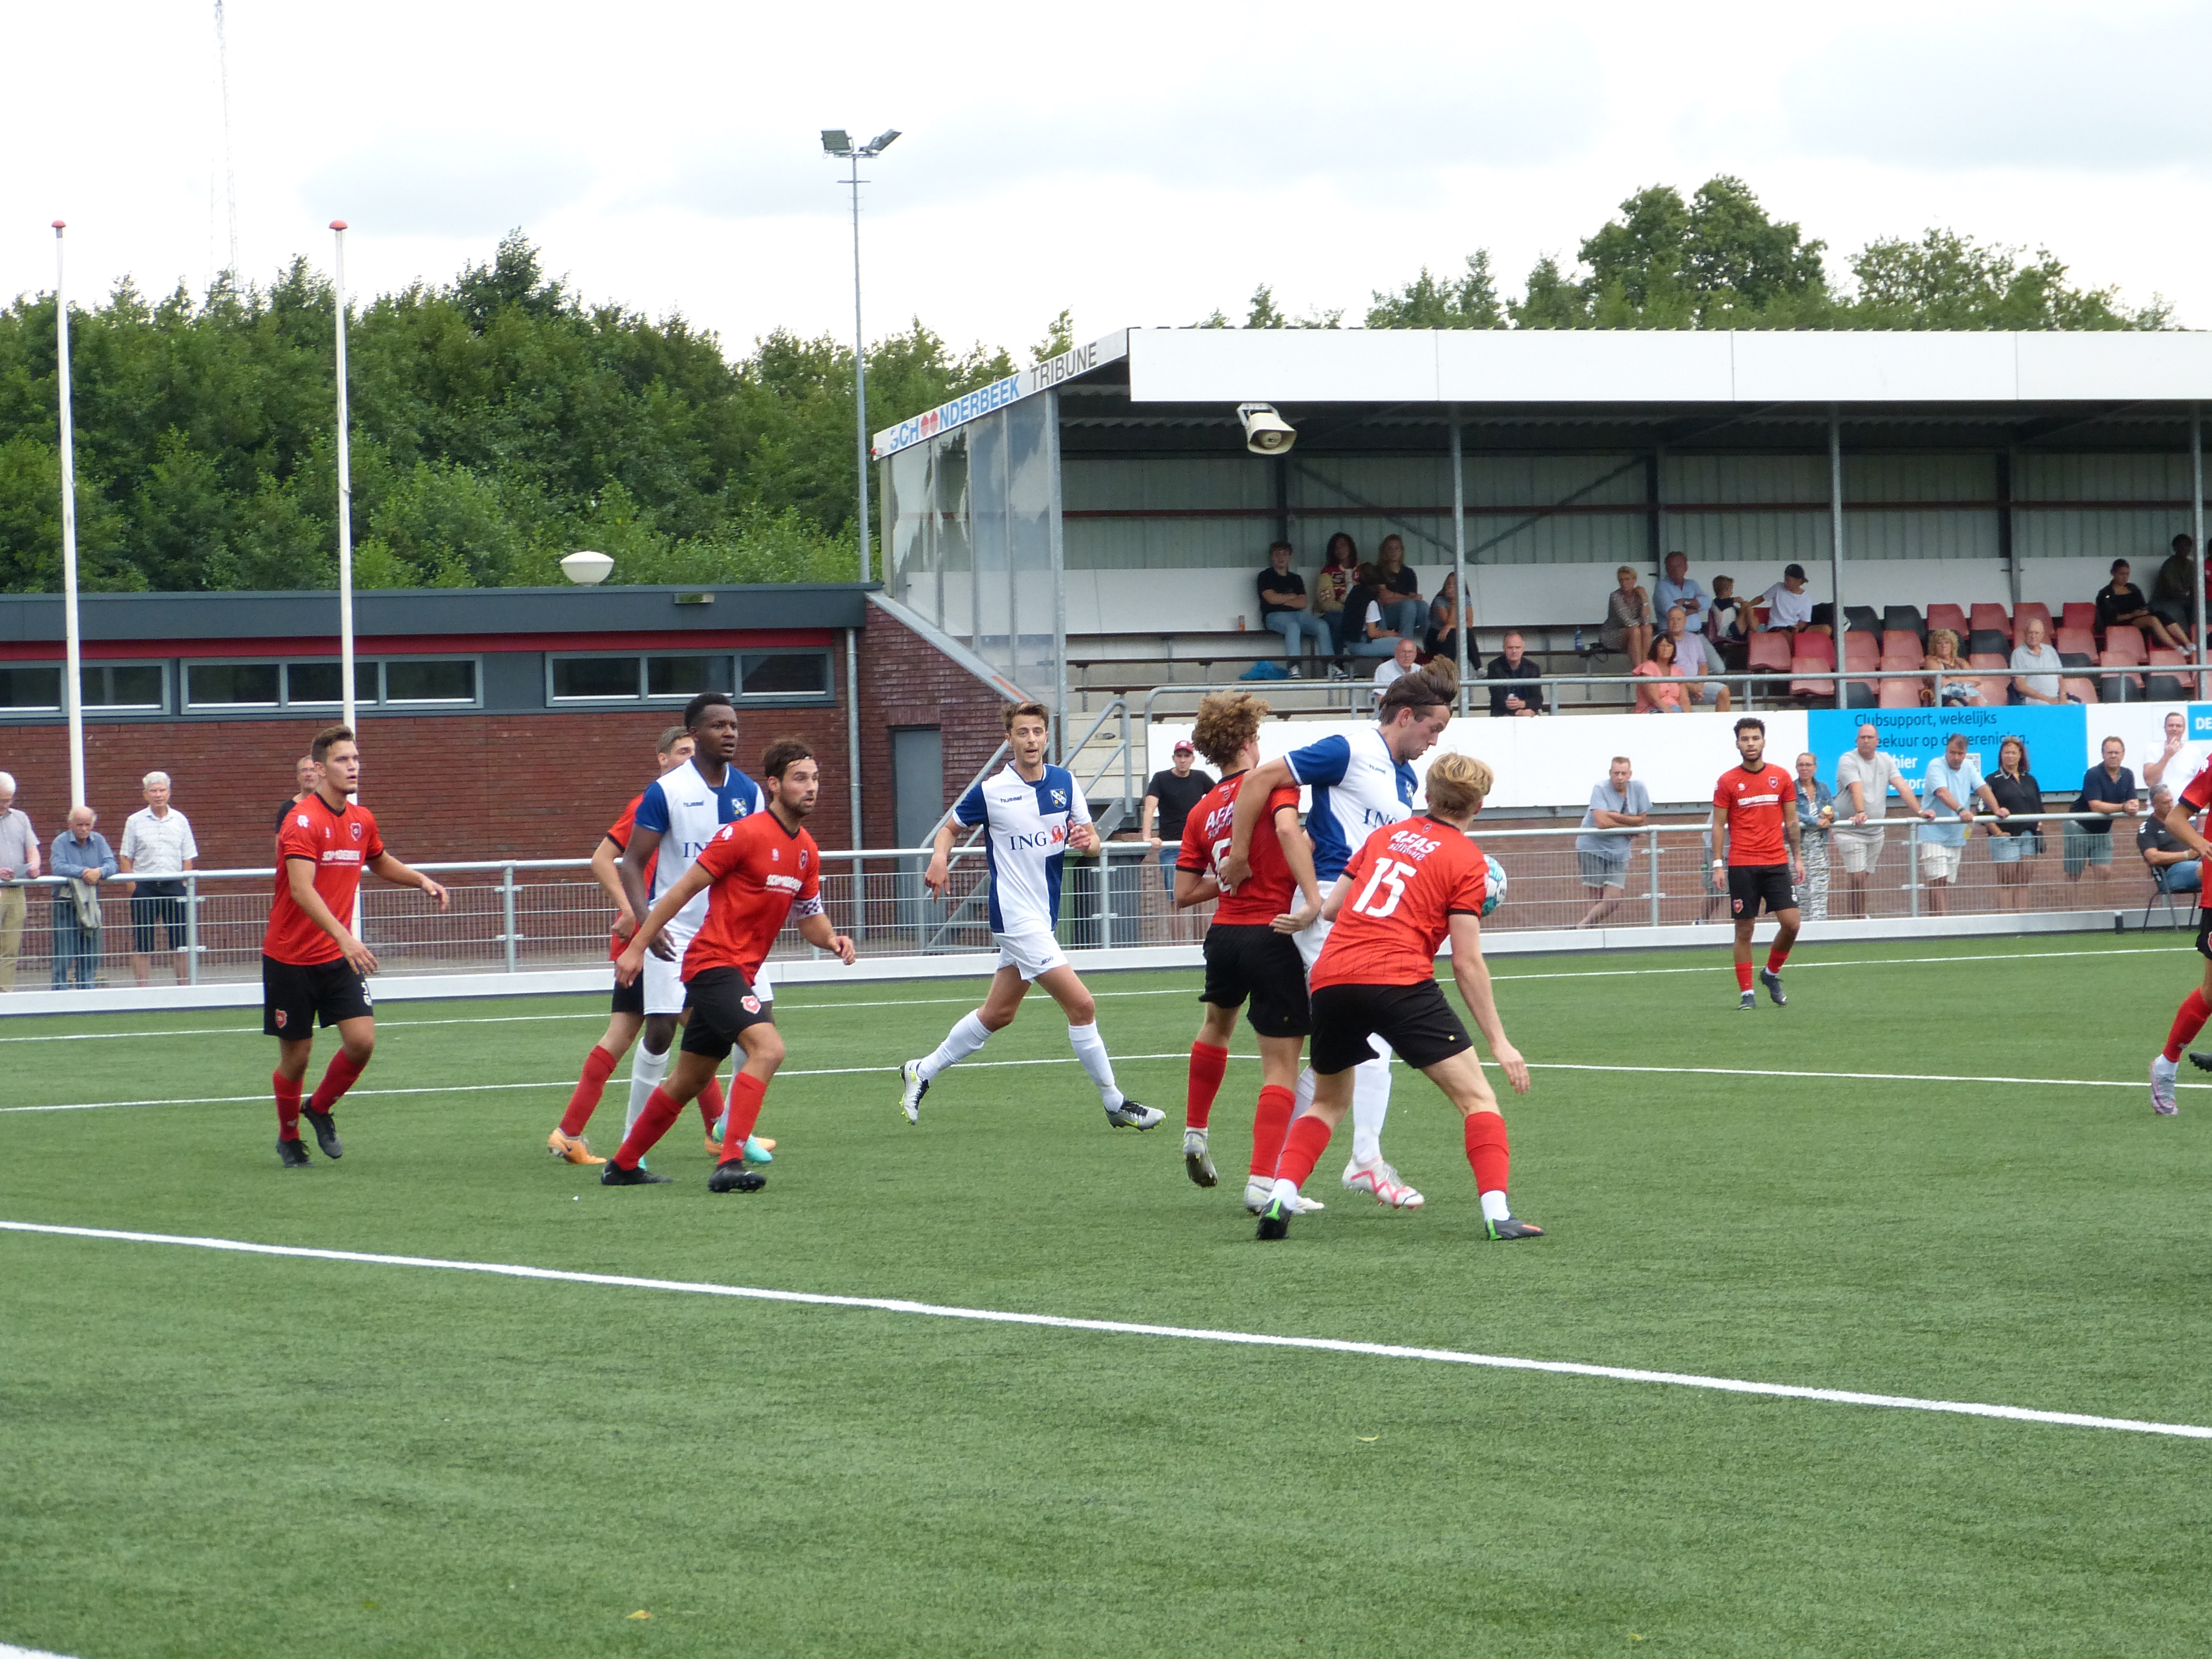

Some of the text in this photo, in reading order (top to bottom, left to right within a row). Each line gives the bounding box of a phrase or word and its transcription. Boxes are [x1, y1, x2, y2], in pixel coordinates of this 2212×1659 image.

[1030, 341, 1097, 391] TRIBUNE
[1854, 710, 1997, 729] Clubsupport, wekelijks
[1922, 736, 1938, 749] op
[1204, 801, 1234, 832] AFA
[682, 841, 709, 858] IN
[1009, 831, 1047, 851] ING
[1390, 830, 1442, 854] AFAS
[1352, 857, 1417, 918] 15
